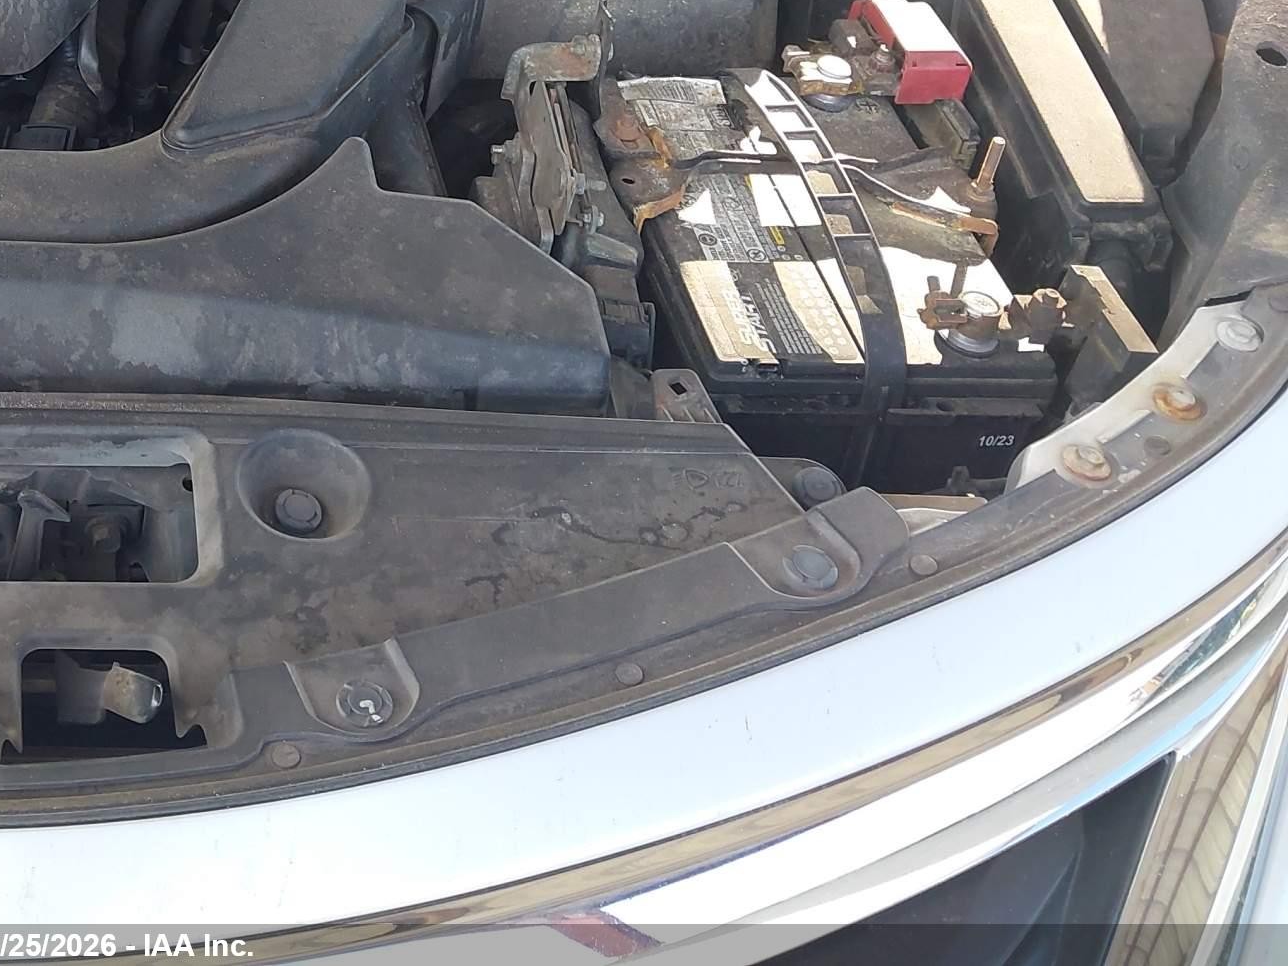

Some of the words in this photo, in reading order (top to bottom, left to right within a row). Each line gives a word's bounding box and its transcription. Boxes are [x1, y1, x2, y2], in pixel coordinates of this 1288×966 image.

[720, 288, 754, 345] SUPER
[737, 292, 777, 354] START
[978, 435, 1015, 447] 10/23
